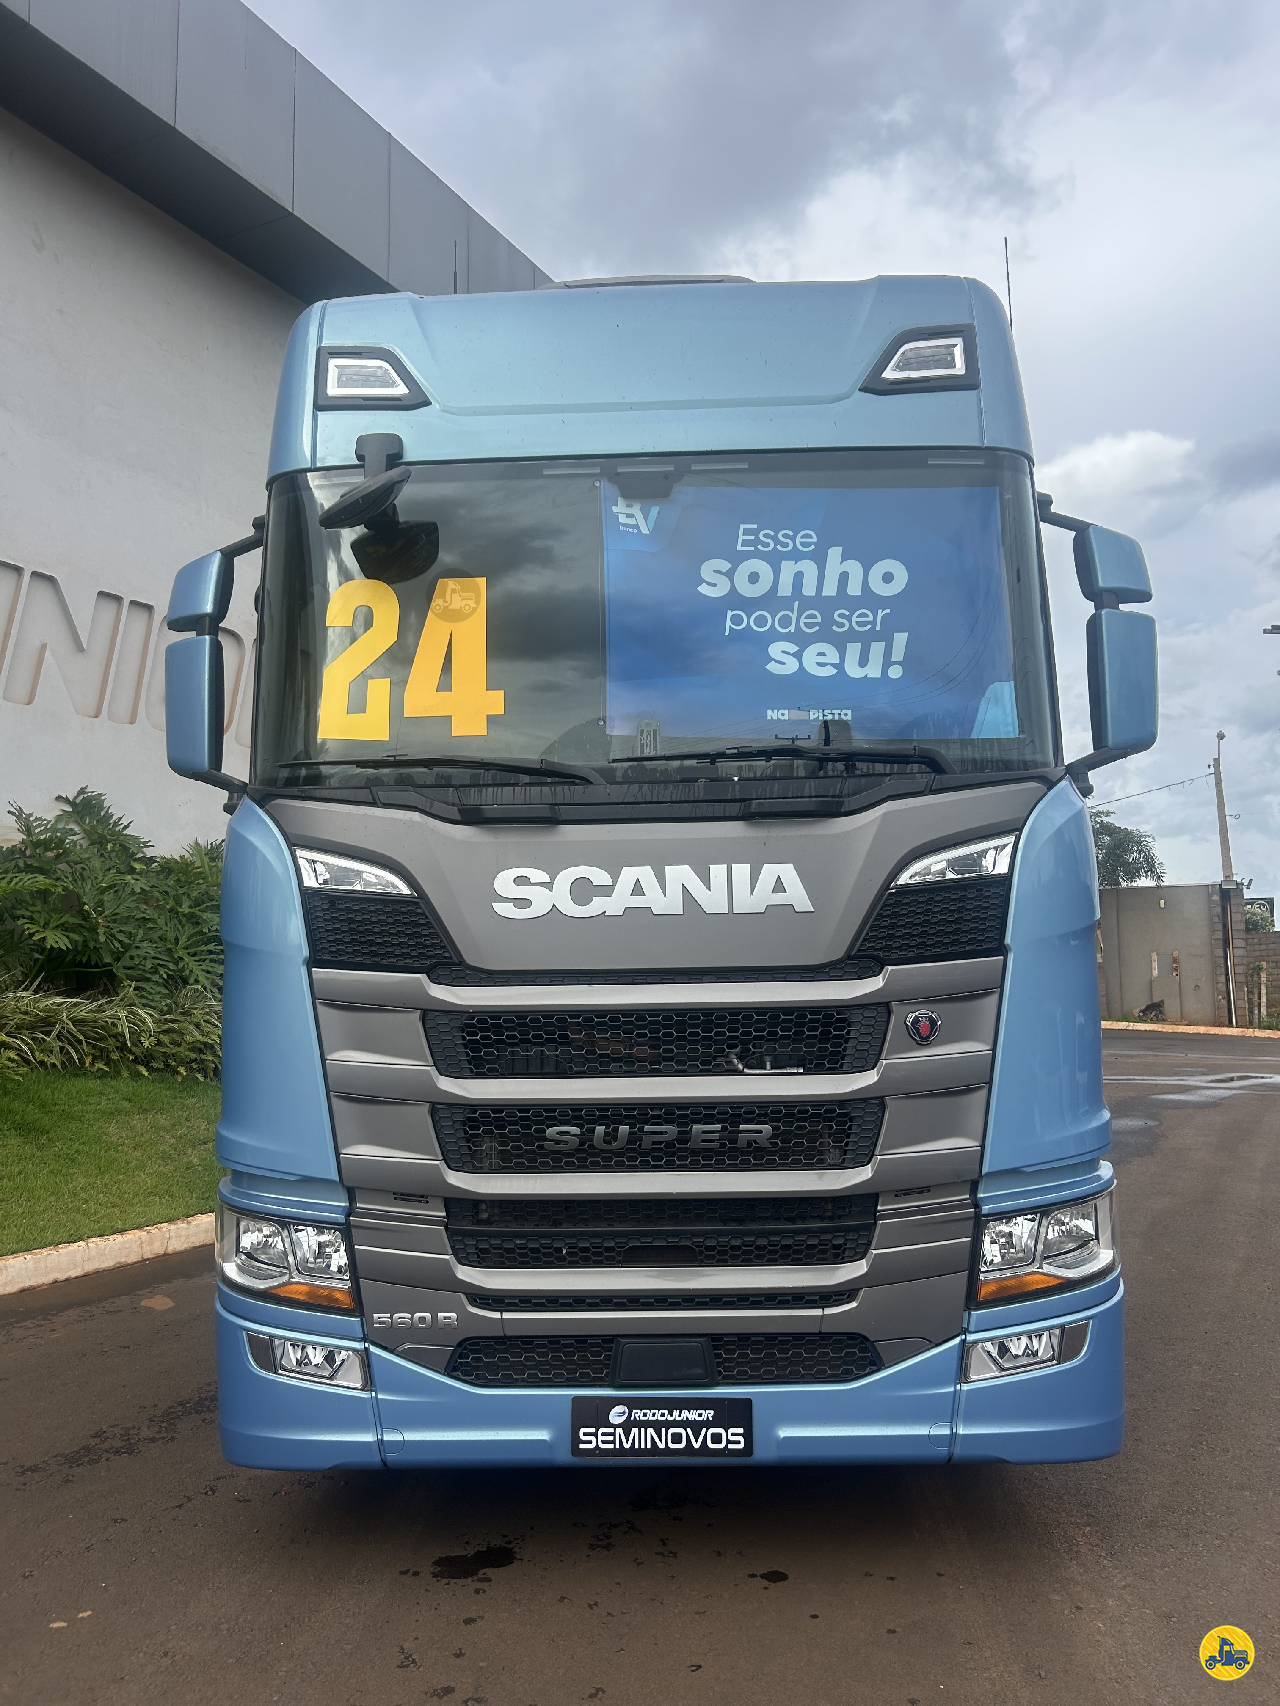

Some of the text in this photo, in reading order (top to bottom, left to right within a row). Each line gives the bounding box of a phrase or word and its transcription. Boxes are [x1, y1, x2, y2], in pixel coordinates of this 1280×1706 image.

[736, 523, 818, 552] Esse
[696, 546, 909, 598] sonho
[724, 600, 891, 636] pode ser
[318, 576, 505, 741] 24
[765, 632, 909, 679] seu!
[491, 863, 815, 920] SCANIA
[543, 1124, 774, 1151] SUPER
[372, 1312, 458, 1329] 560 R
[630, 1409, 715, 1421] RODOJUNIOR
[578, 1427, 745, 1450] SEMINOVOS
